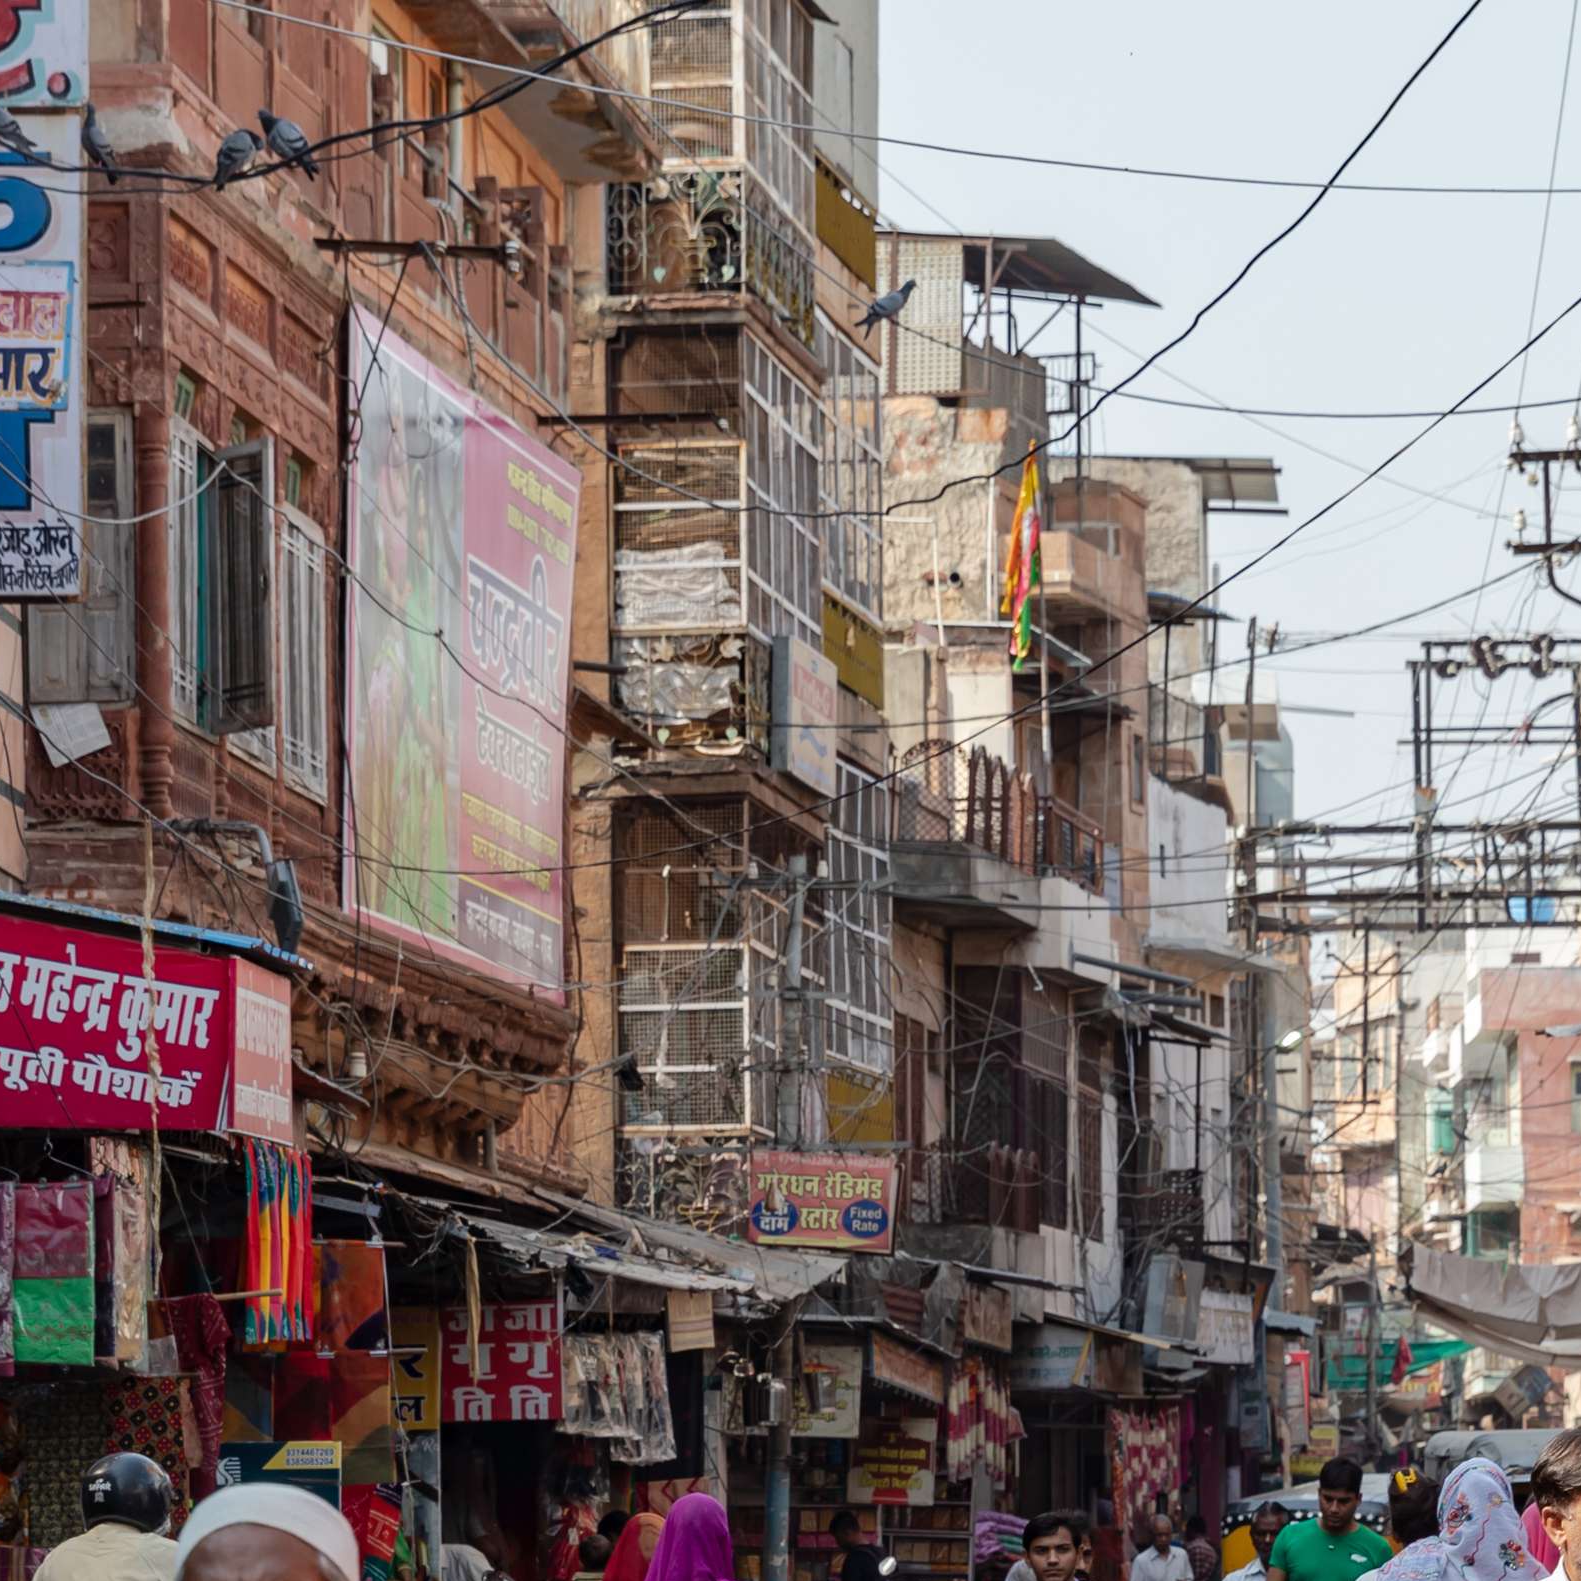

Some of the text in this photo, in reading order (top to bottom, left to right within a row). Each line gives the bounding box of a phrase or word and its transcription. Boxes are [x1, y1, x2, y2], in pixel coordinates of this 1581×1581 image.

[20, 943, 119, 1032] महेन्द्र
[850, 1206, 882, 1220] Fixed
[852, 1220, 879, 1233] Rate
